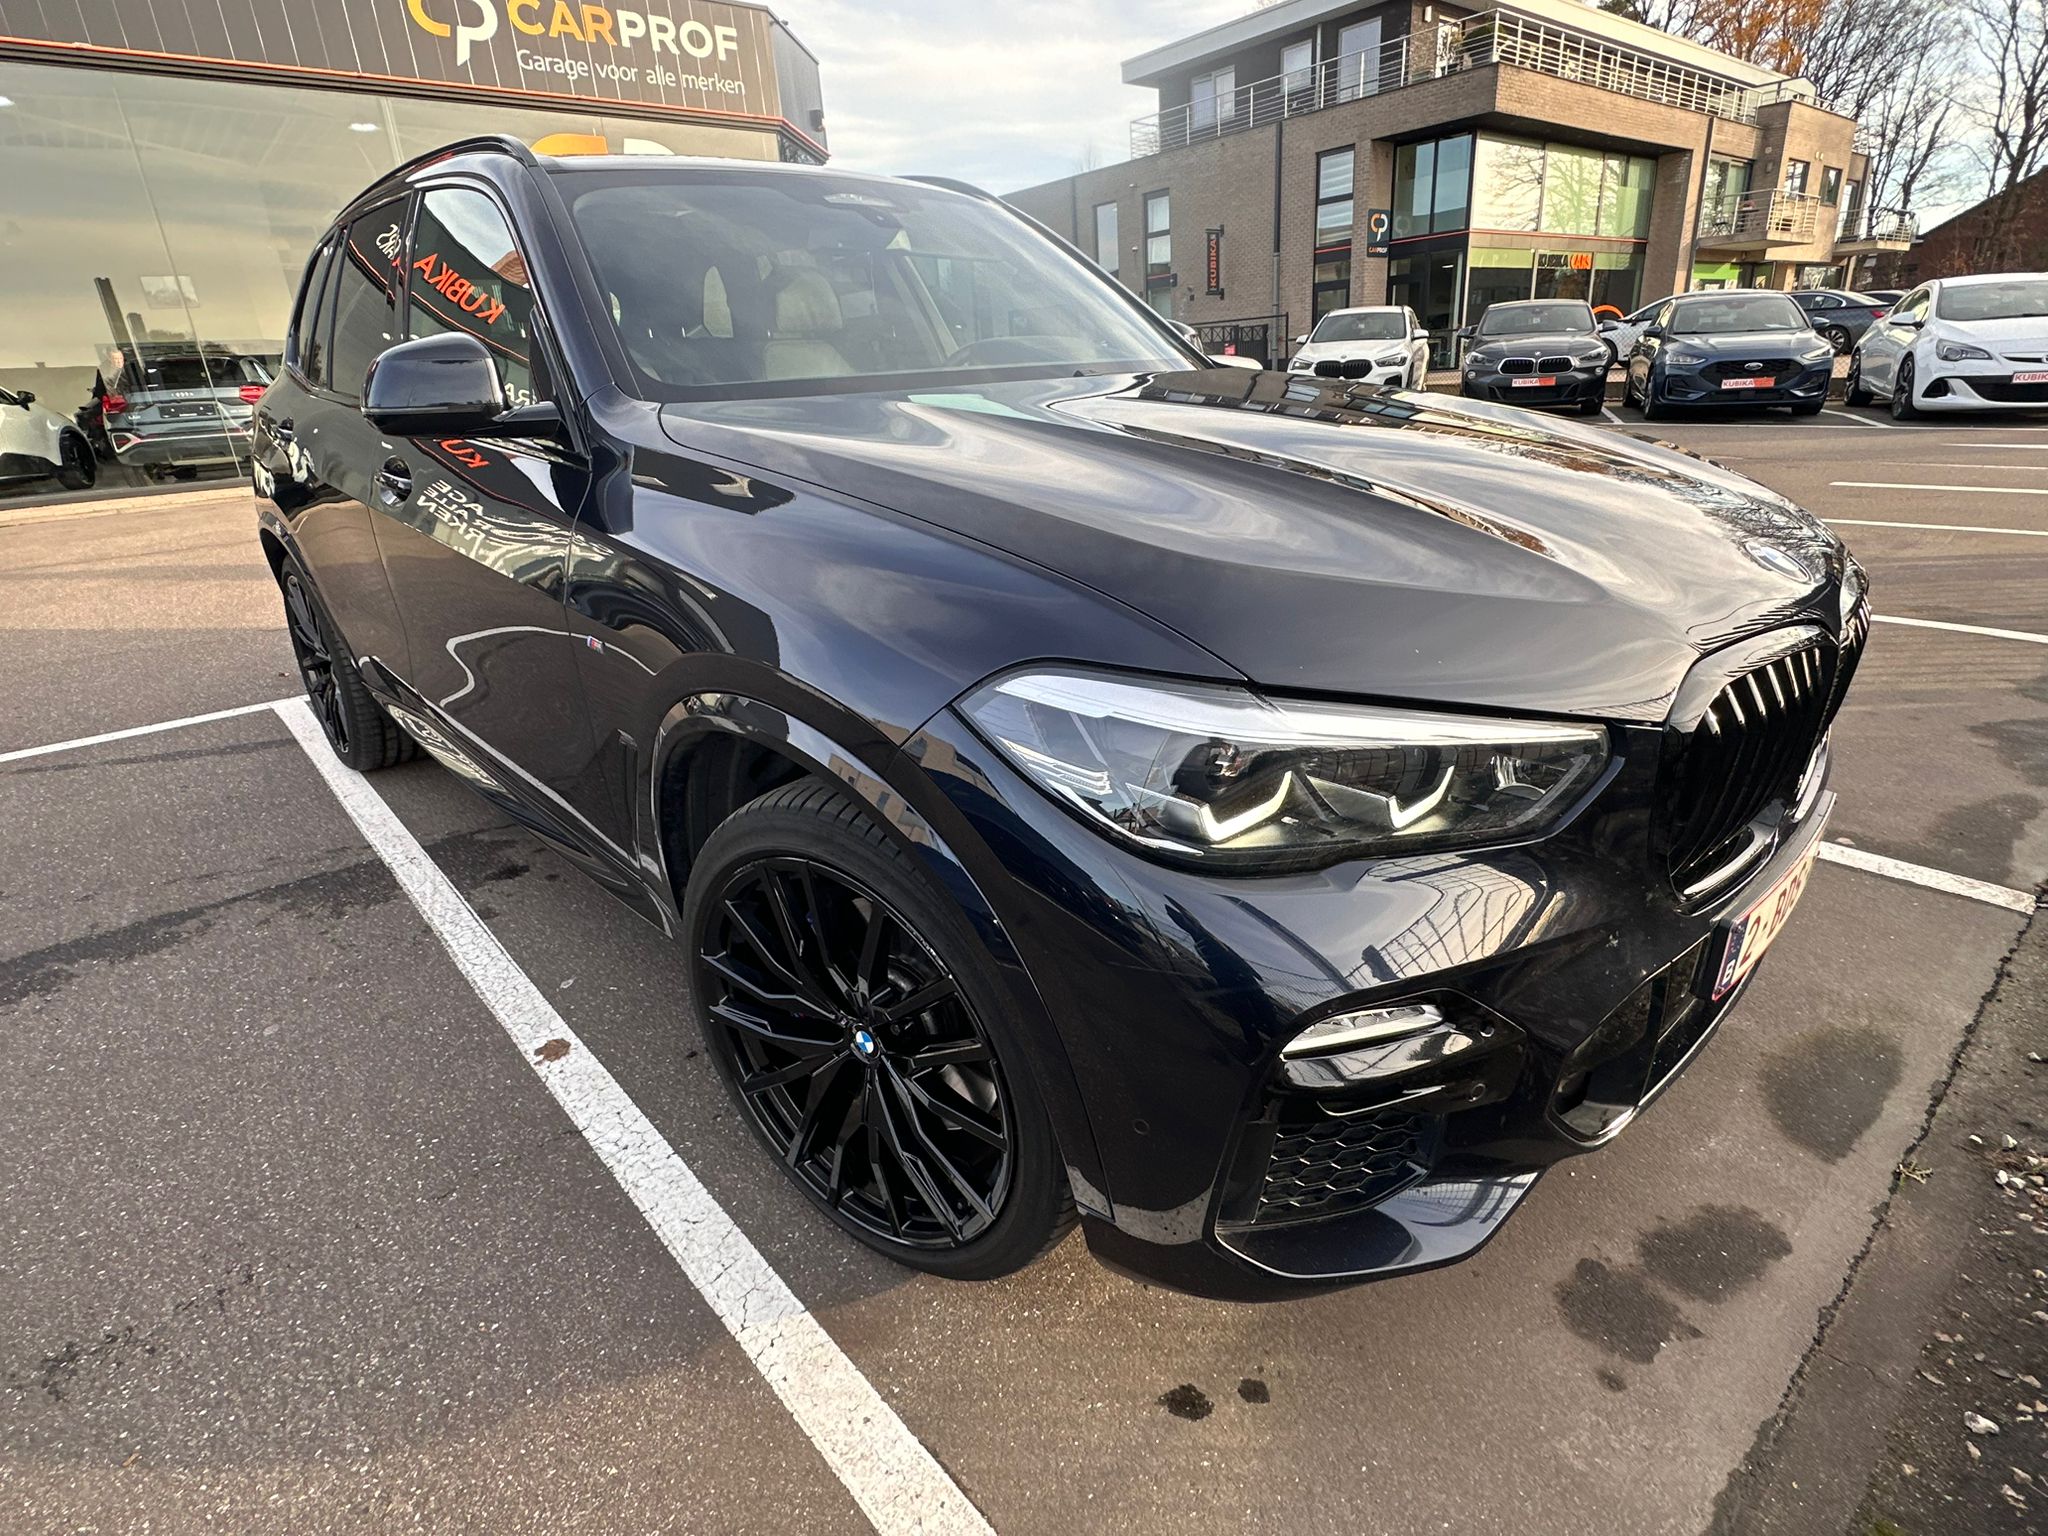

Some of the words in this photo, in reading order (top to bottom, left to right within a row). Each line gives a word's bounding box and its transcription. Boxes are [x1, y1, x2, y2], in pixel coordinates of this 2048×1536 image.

[507, 0, 739, 60] CARPROF
[517, 49, 589, 80] Garage
[599, 63, 638, 82] voor
[646, 65, 676, 88] alle
[683, 71, 745, 96] merken
[1723, 379, 1753, 387] KUBIKA
